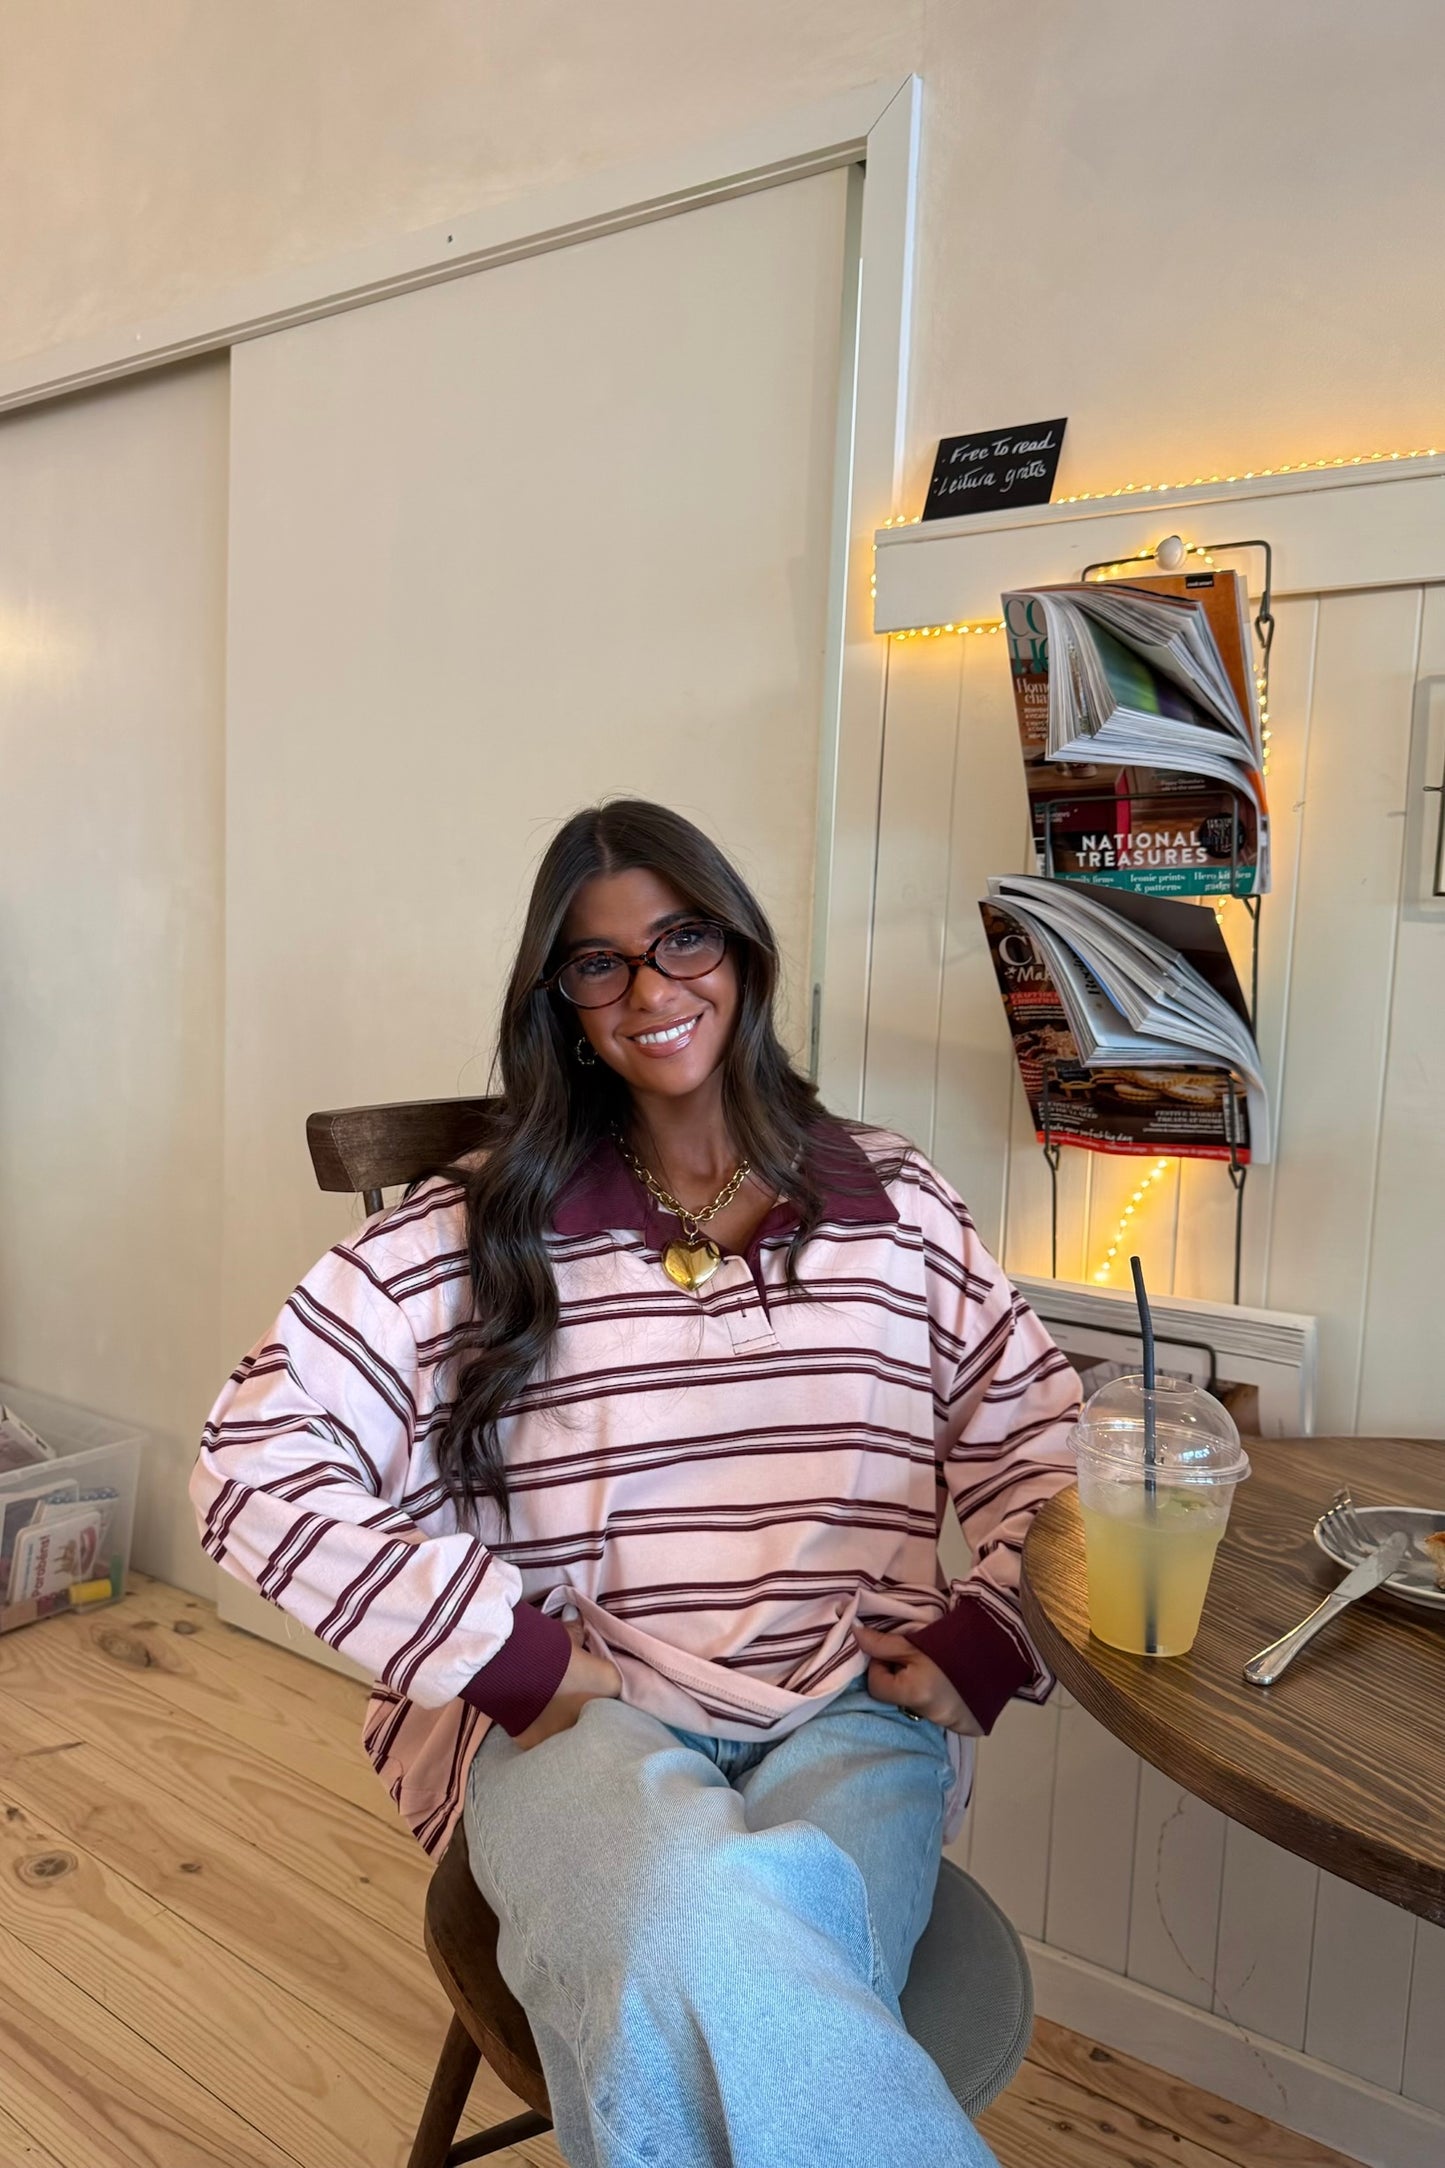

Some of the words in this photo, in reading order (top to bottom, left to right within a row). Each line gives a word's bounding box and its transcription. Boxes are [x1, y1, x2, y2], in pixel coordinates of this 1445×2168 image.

[950, 444, 989, 464] Free
[1012, 430, 1056, 454] read
[937, 466, 997, 496] Leitura
[1082, 831, 1202, 851] NATIONAL
[1075, 848, 1209, 868] TREASURES
[1158, 872, 1186, 884] prints
[1218, 869, 1252, 880] kithen
[1134, 883, 1142, 892] &
